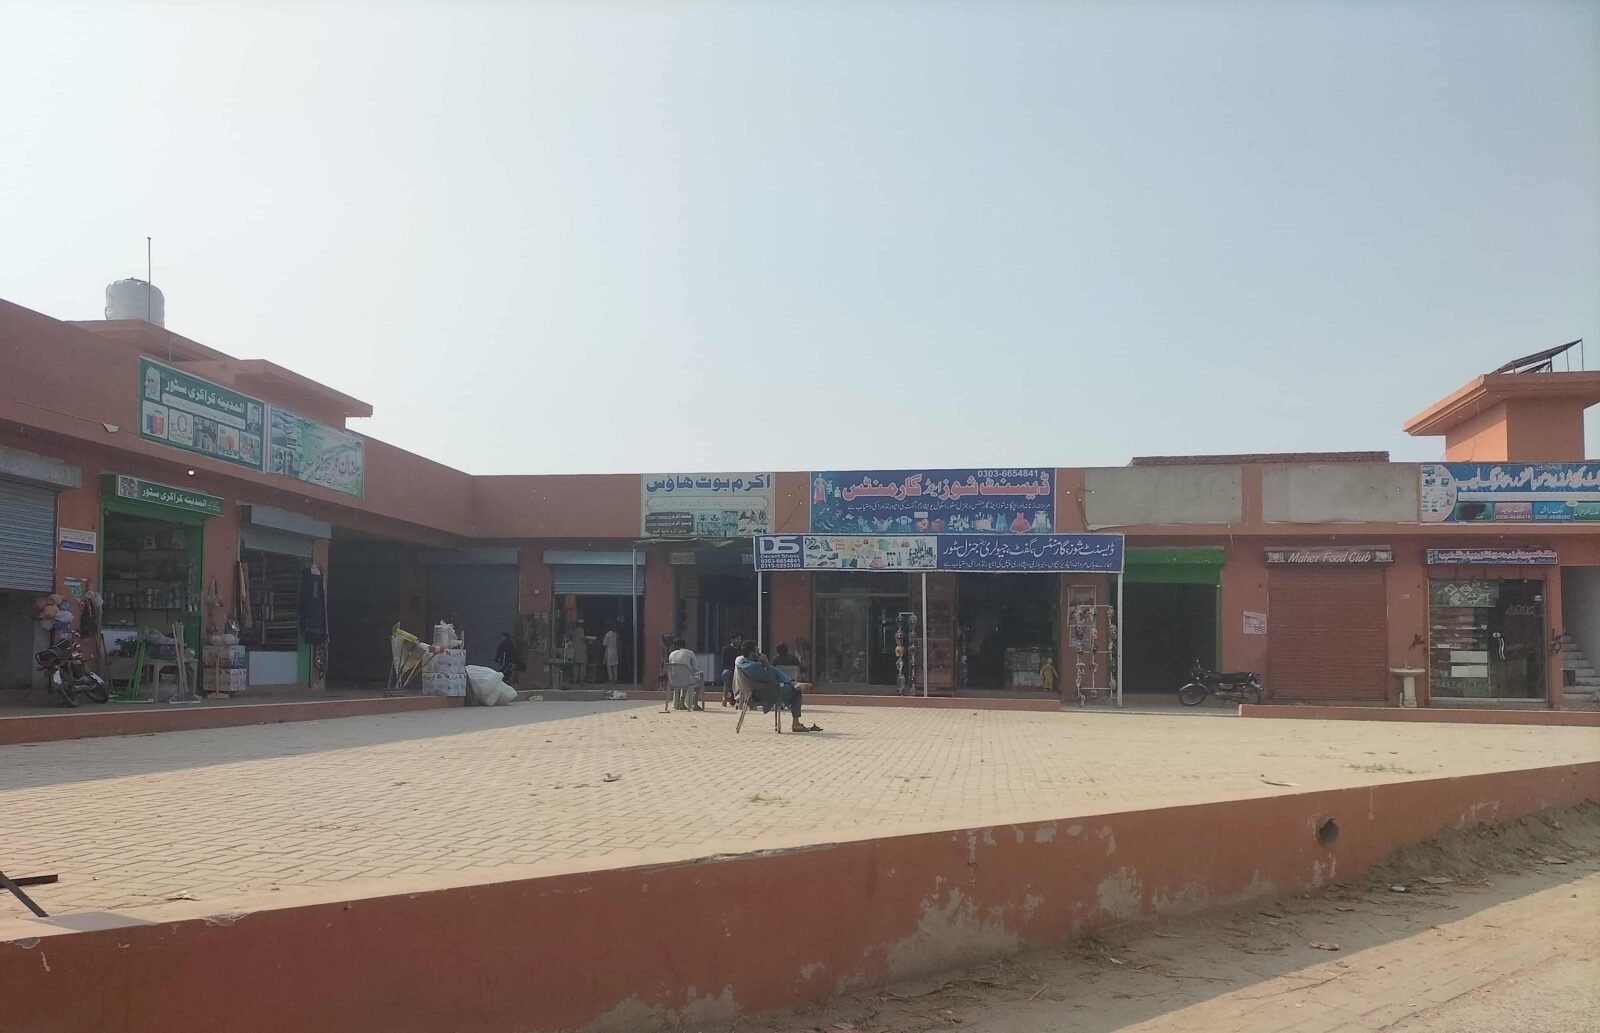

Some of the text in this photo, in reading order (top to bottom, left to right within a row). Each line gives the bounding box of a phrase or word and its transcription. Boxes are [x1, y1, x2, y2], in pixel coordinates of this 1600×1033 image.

[164, 378, 187, 394] سٹور
[188, 387, 216, 405] کراکری
[217, 397, 245, 414] المدینہ
[977, 469, 1038, 478] 0303-6654841
[695, 476, 730, 492] بوٹ
[732, 474, 771, 493] اکرم
[842, 473, 923, 501] گارمنٹس
[938, 475, 979, 501] شوز
[979, 470, 1051, 500] ڈیسنٹ
[142, 487, 160, 497] سٹور
[160, 491, 183, 504] کراکری
[184, 496, 207, 508] المدینہ
[759, 536, 800, 554] DS
[942, 540, 964, 555] سٹور
[957, 539, 979, 557] جنرل
[980, 540, 1009, 558] جیولری
[1080, 541, 1115, 557] ڈیسنٹ
[1288, 551, 1371, 563] Maher Food Club
